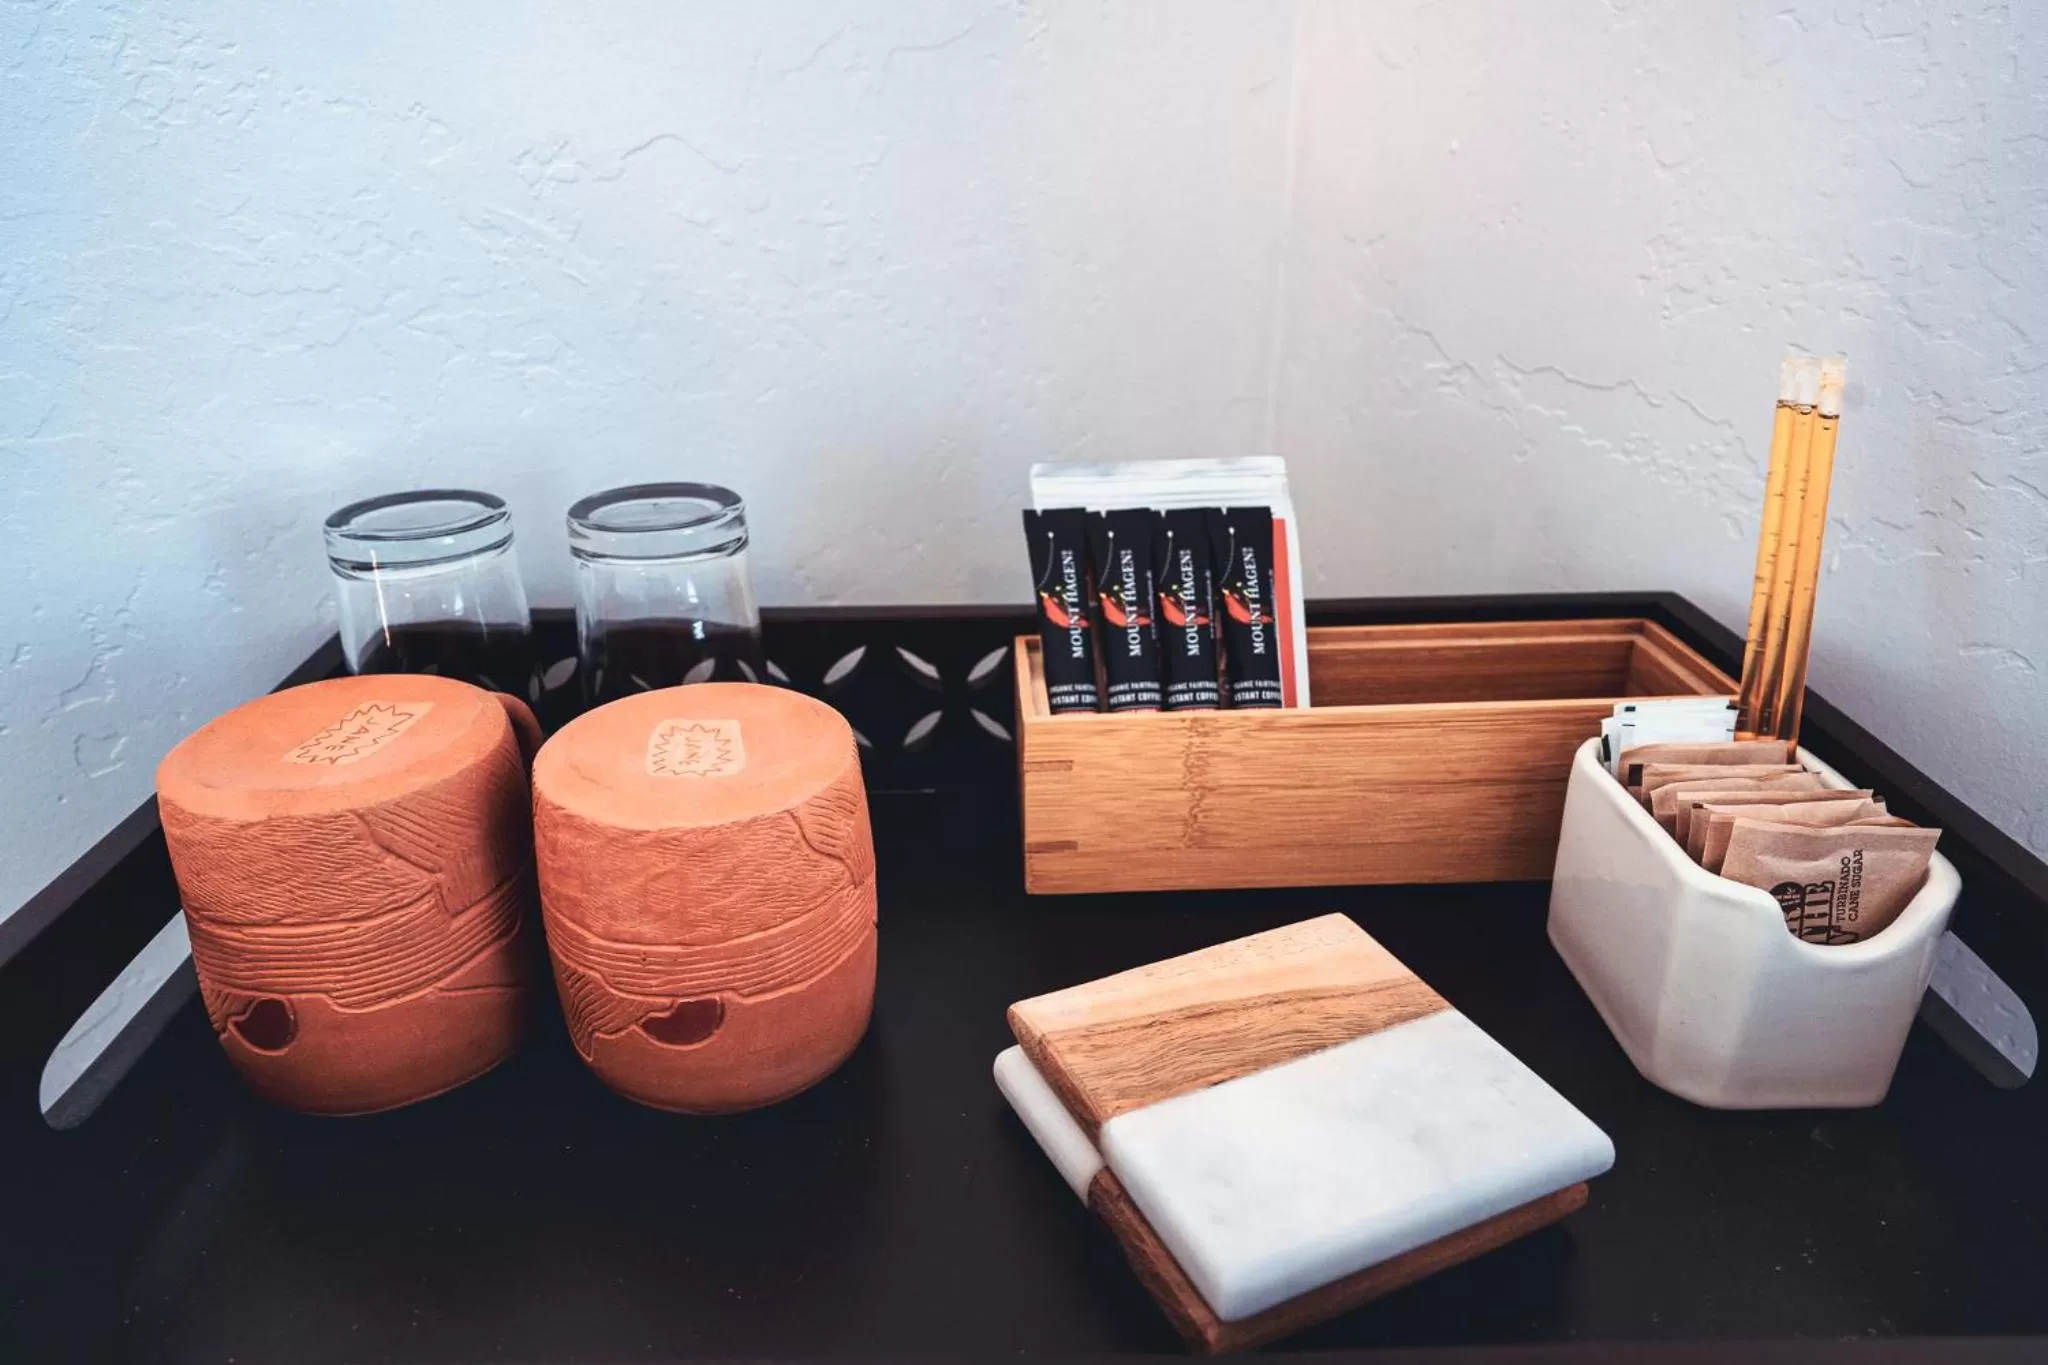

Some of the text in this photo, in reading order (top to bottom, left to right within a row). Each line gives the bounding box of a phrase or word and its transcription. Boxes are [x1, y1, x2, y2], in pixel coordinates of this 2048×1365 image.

[1068, 606, 1084, 658] MOUNT
[1125, 606, 1142, 656] MOUNT
[1184, 605, 1200, 656] MOUNT
[1248, 603, 1265, 654] MOUNT
[1836, 856, 1851, 923] TURBINADO
[1848, 849, 1864, 922] CANE SUGAR
